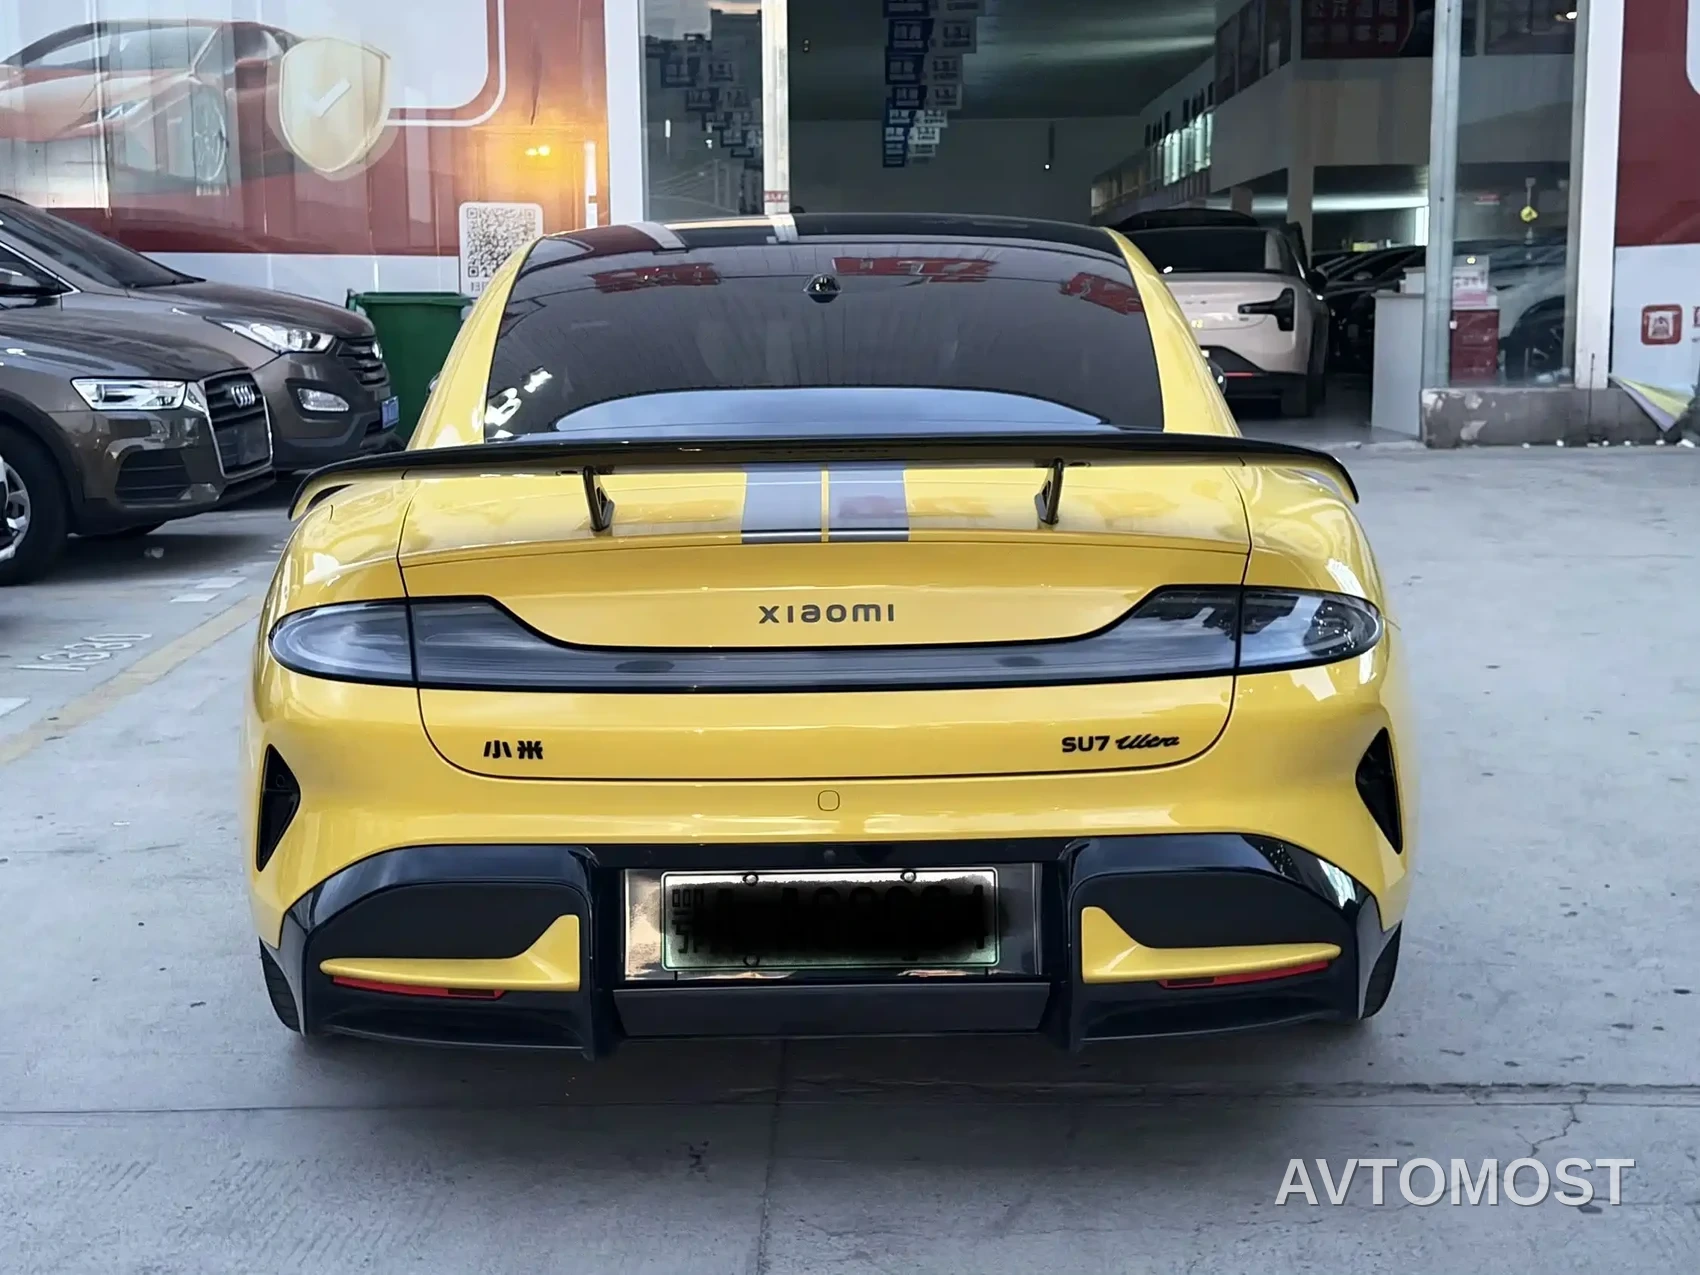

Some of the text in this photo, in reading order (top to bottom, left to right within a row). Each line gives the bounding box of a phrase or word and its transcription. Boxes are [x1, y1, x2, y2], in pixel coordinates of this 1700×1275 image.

[758, 604, 894, 624] xiaomi
[483, 740, 544, 760] 小米
[1061, 733, 1180, 753] SU7 Ultra
